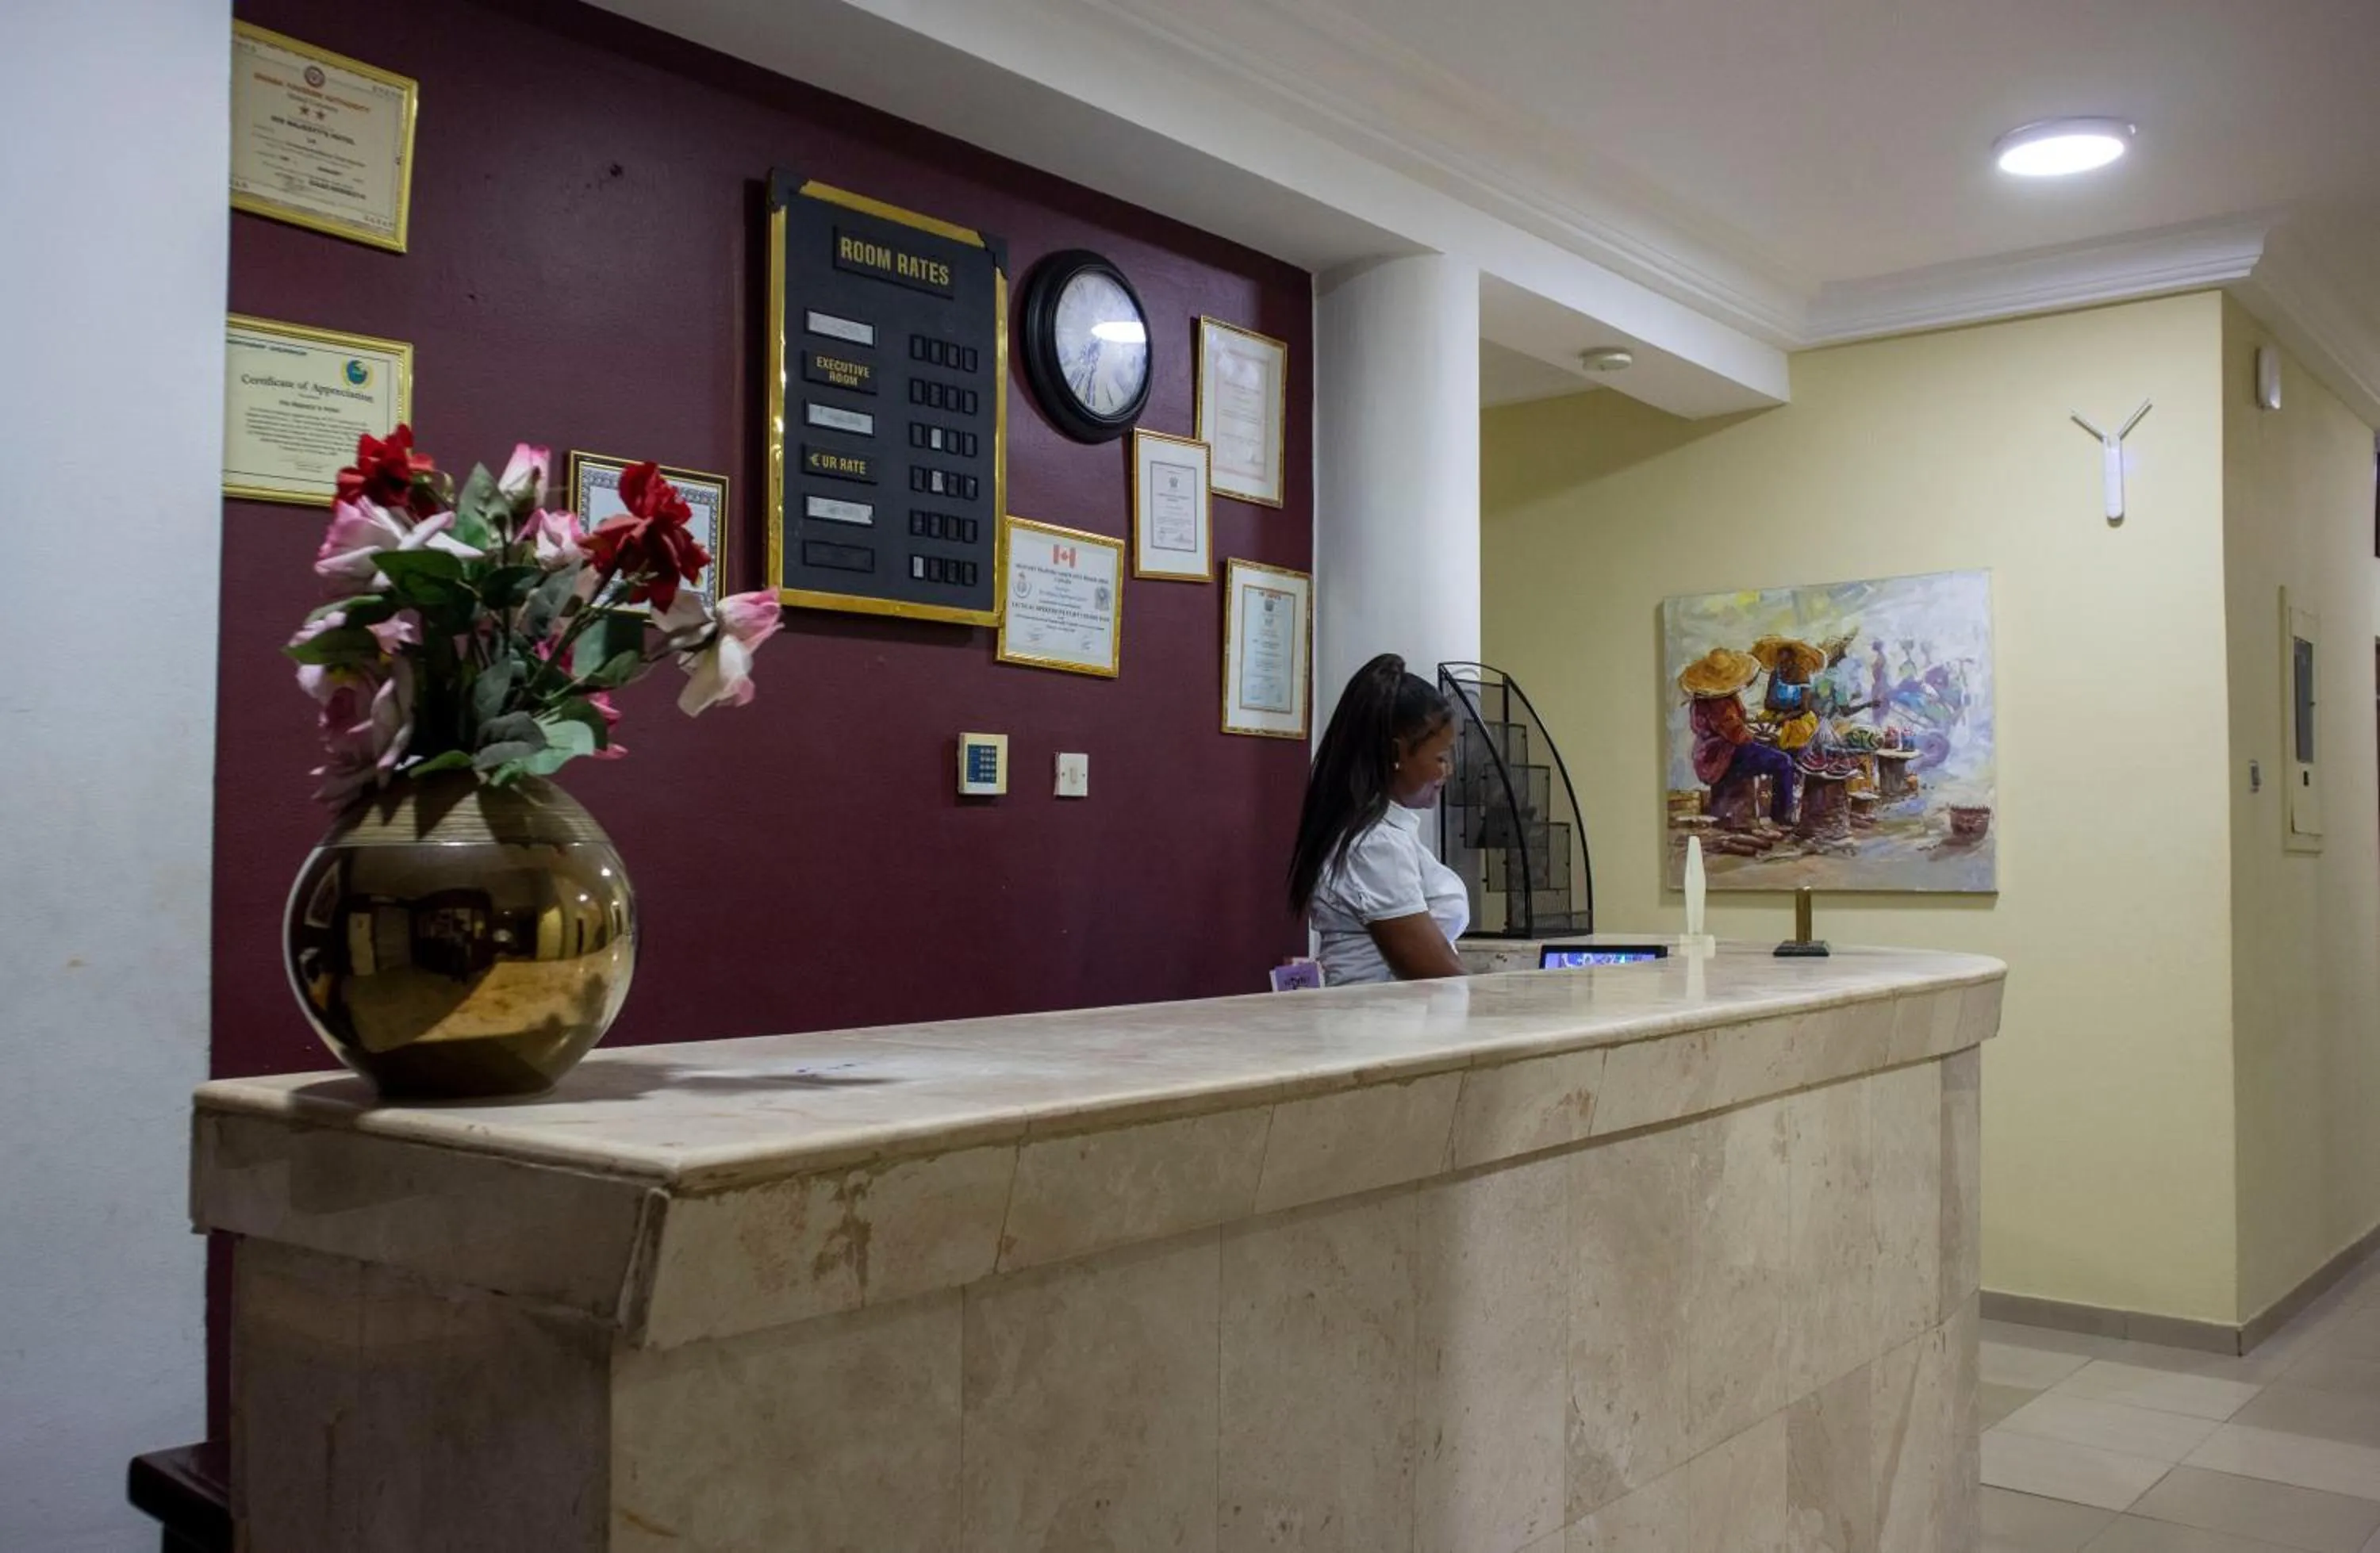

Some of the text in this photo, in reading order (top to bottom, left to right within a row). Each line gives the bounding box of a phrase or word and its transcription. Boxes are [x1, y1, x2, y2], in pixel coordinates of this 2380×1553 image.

[841, 236, 949, 286] ROOM RATES
[816, 356, 870, 378] EXECUTIVE
[241, 374, 294, 389] Certificate
[297, 381, 309, 389] of
[313, 383, 374, 403] Appreciation
[829, 370, 858, 387] ROOM
[839, 458, 866, 475] RATE
